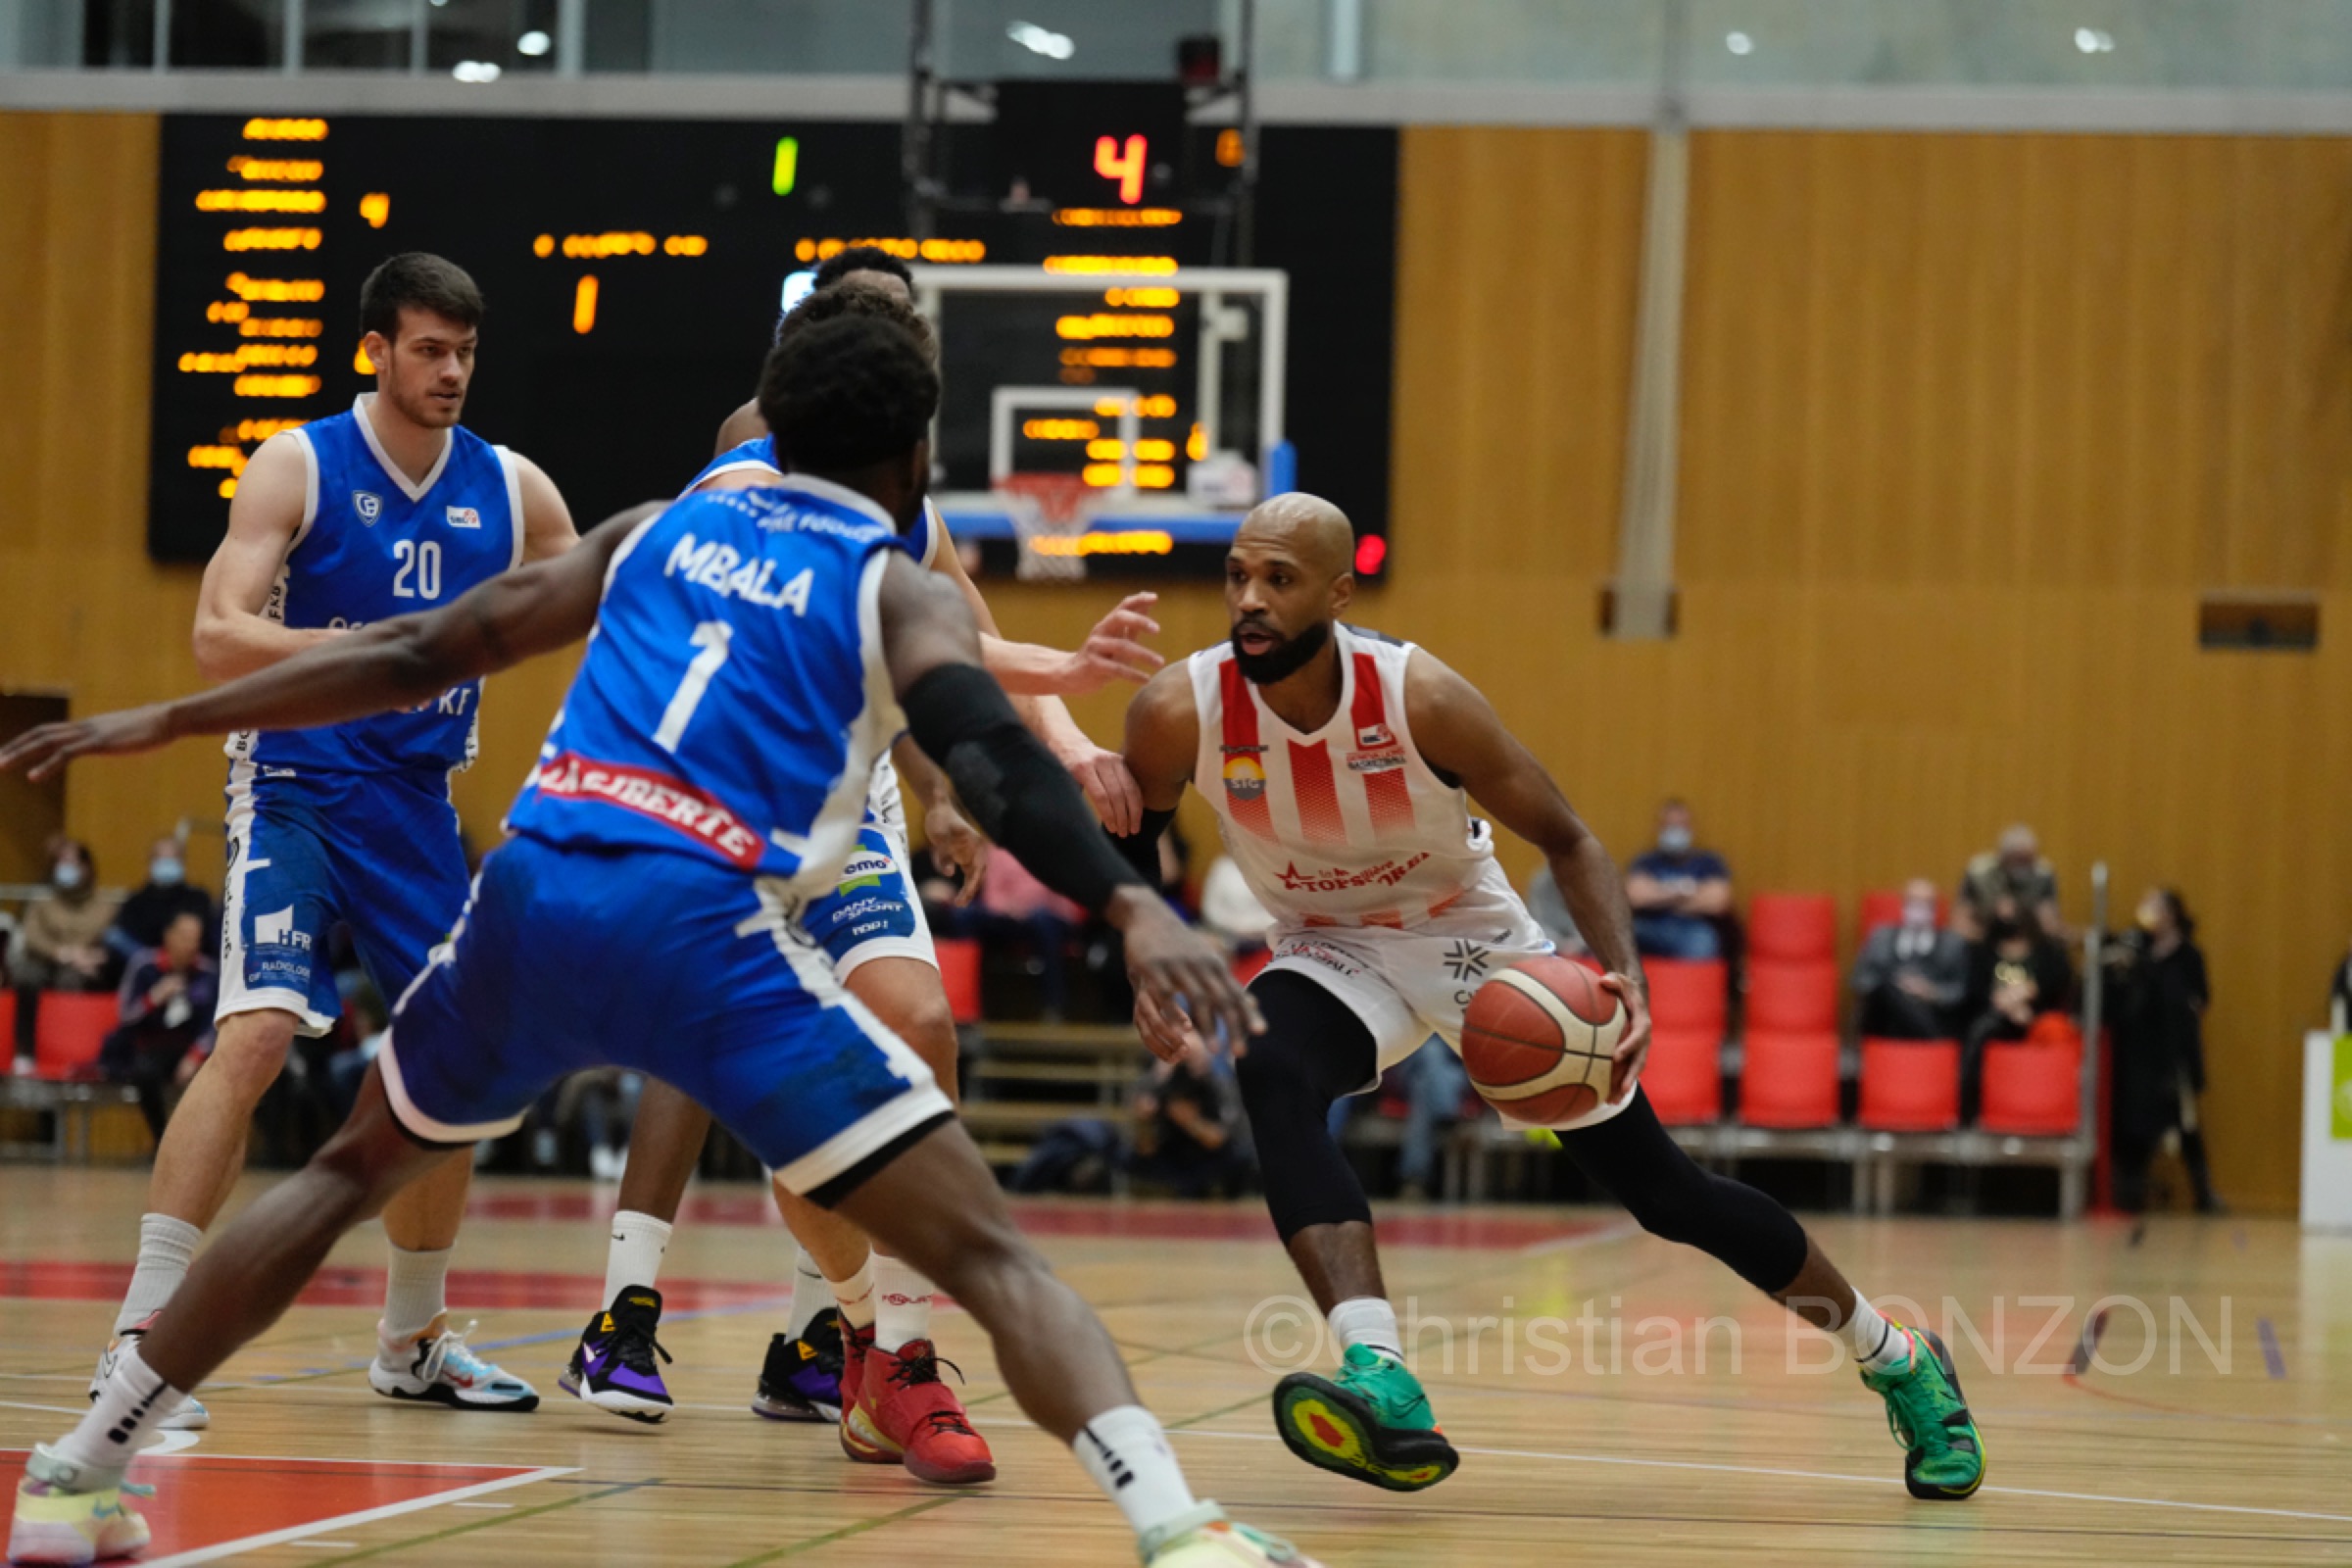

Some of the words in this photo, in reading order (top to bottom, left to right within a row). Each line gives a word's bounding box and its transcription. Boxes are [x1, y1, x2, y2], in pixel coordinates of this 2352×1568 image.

[1094, 134, 1148, 205] 4
[393, 538, 442, 601] 20
[663, 532, 814, 617] MBALA
[651, 620, 734, 755] 1
